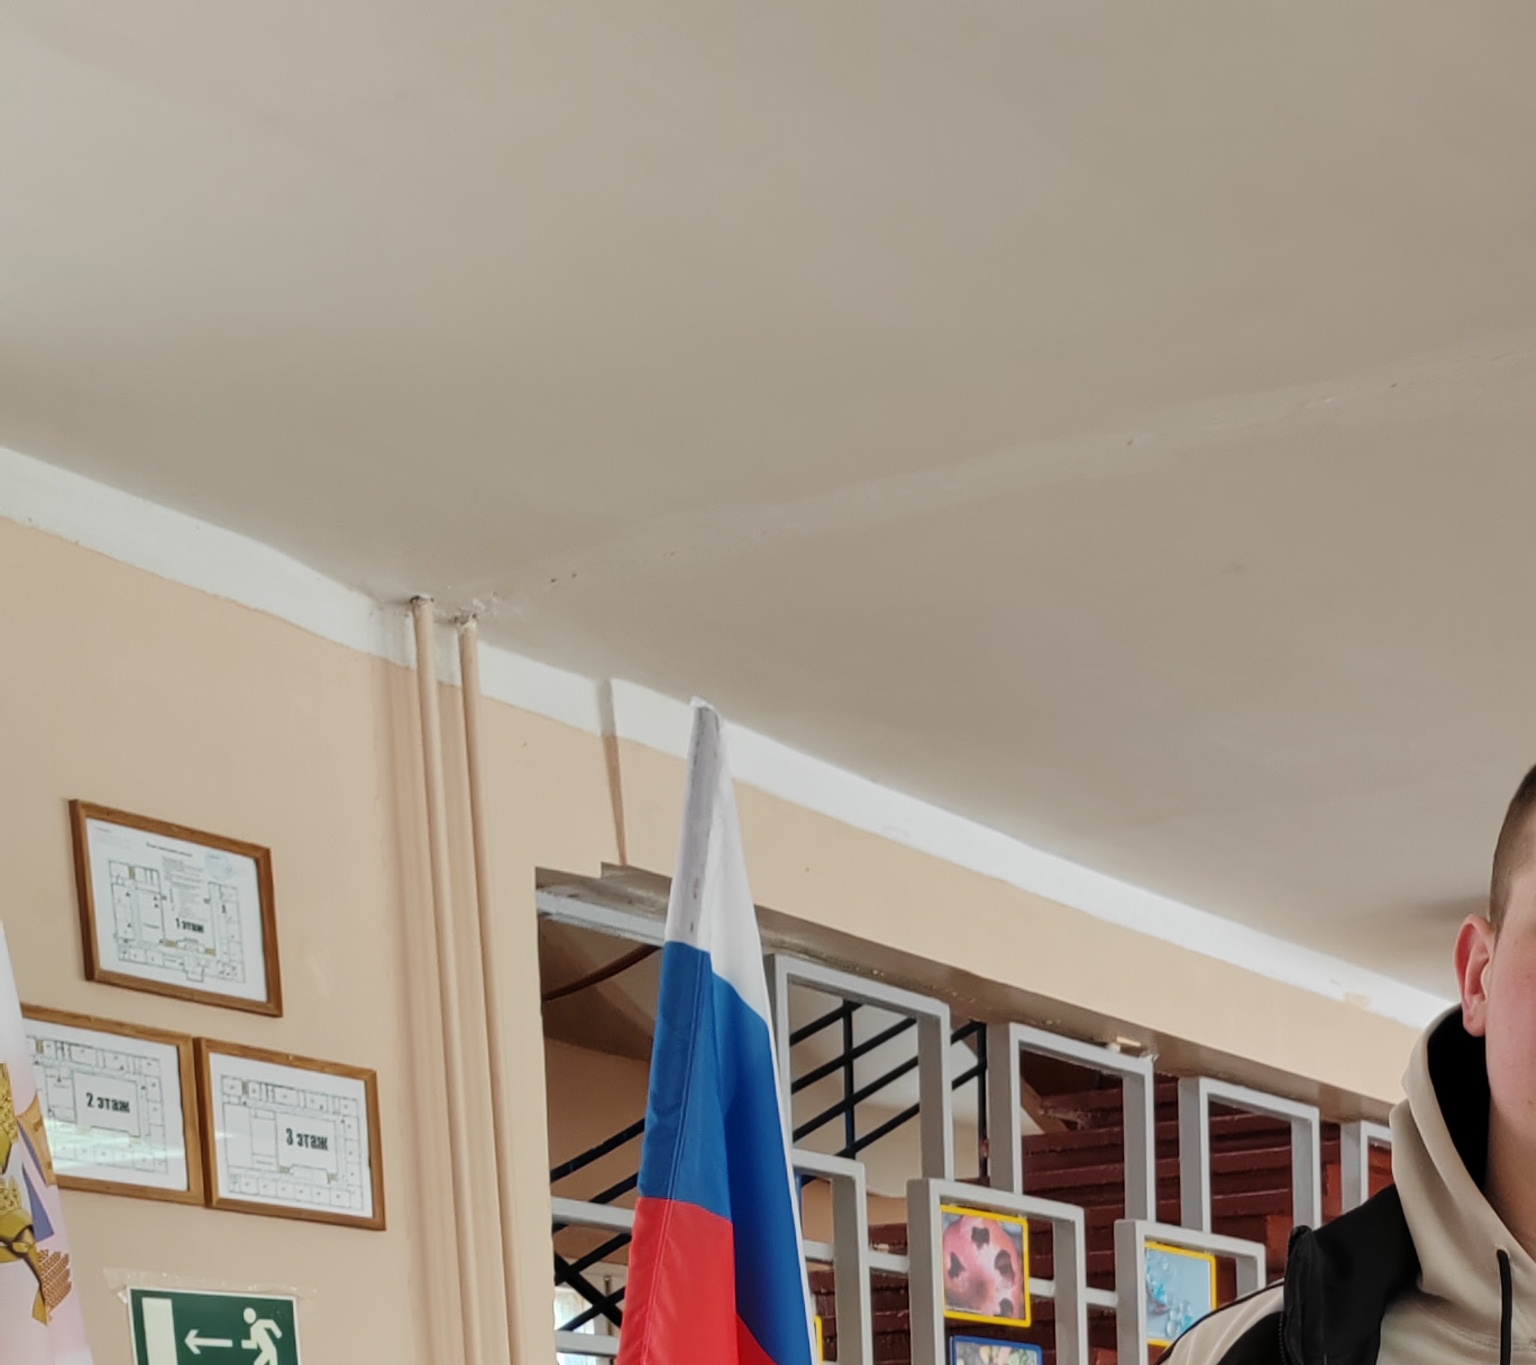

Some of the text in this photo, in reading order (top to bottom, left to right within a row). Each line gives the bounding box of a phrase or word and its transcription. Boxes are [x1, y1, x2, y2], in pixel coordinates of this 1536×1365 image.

[85, 1092, 131, 1114] 2 этаж
[285, 1128, 329, 1151] 3 этаж
